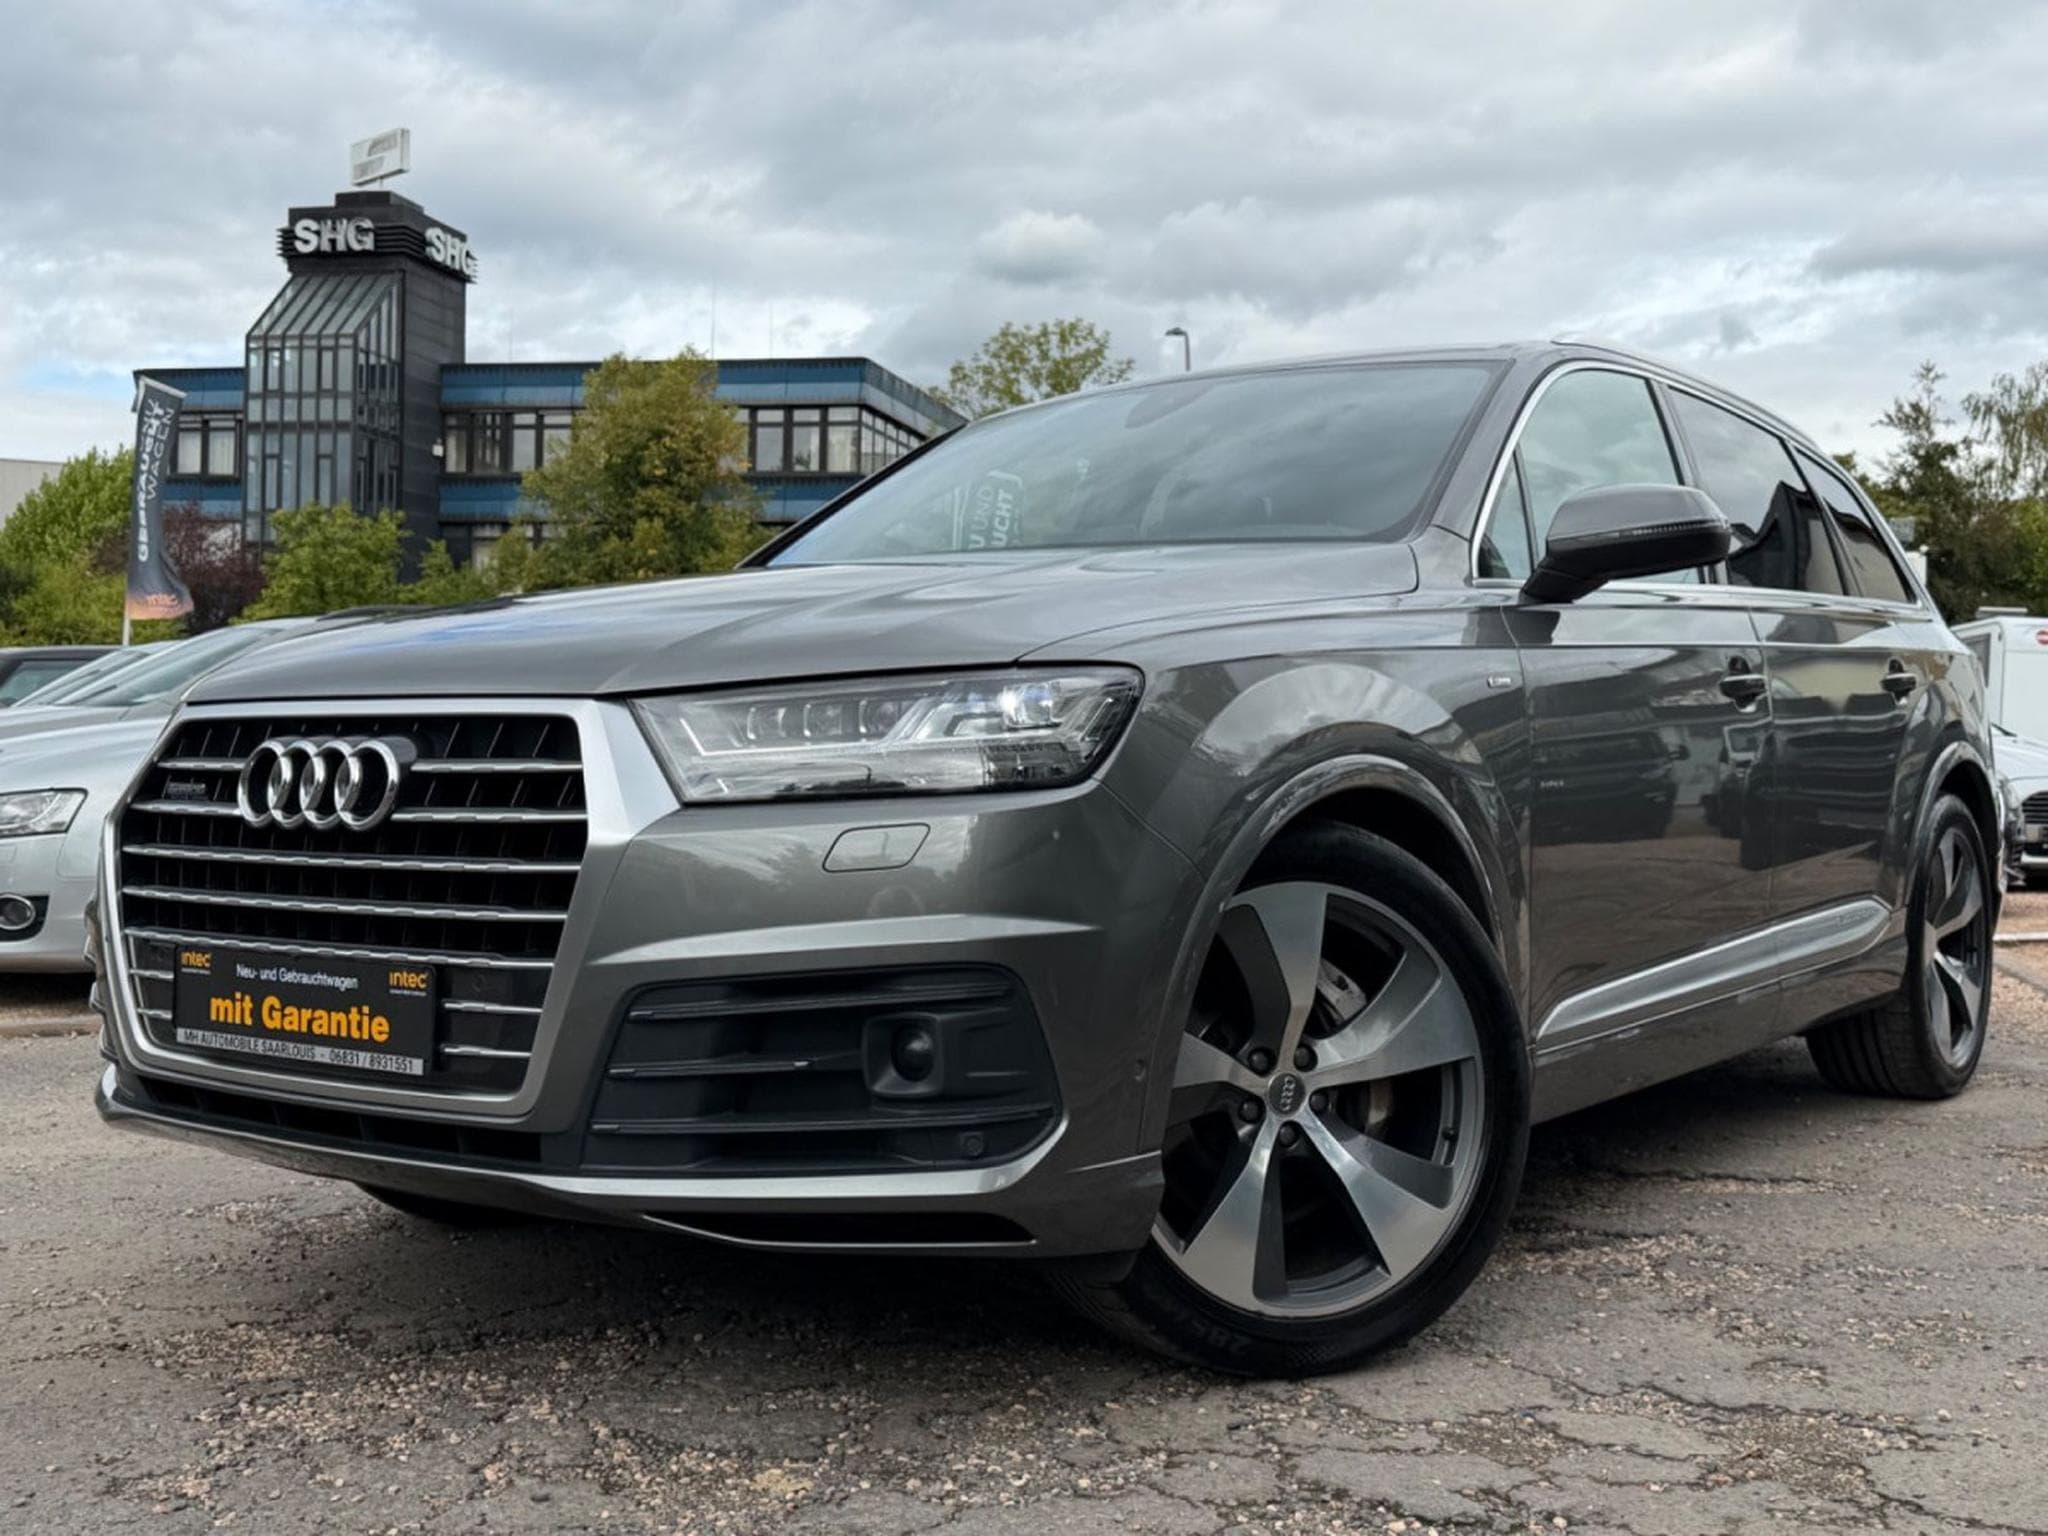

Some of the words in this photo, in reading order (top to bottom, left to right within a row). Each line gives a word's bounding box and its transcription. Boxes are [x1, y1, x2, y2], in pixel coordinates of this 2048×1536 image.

[294, 217, 375, 253] SHG
[147, 407, 175, 500] WAGEN
[181, 951, 211, 968] intec
[236, 963, 258, 979] Neu-
[260, 967, 277, 981] und
[279, 967, 358, 992] Gebrauchtwagen
[389, 971, 428, 989] intec
[210, 991, 253, 1026] mit
[262, 995, 390, 1042] Garantie
[183, 1029, 199, 1042] MH
[201, 1032, 260, 1051] AUTOMOBILE
[261, 1041, 315, 1059] SAARLOUIS
[329, 1048, 359, 1064] 06831
[369, 1052, 413, 1073] 8931551
